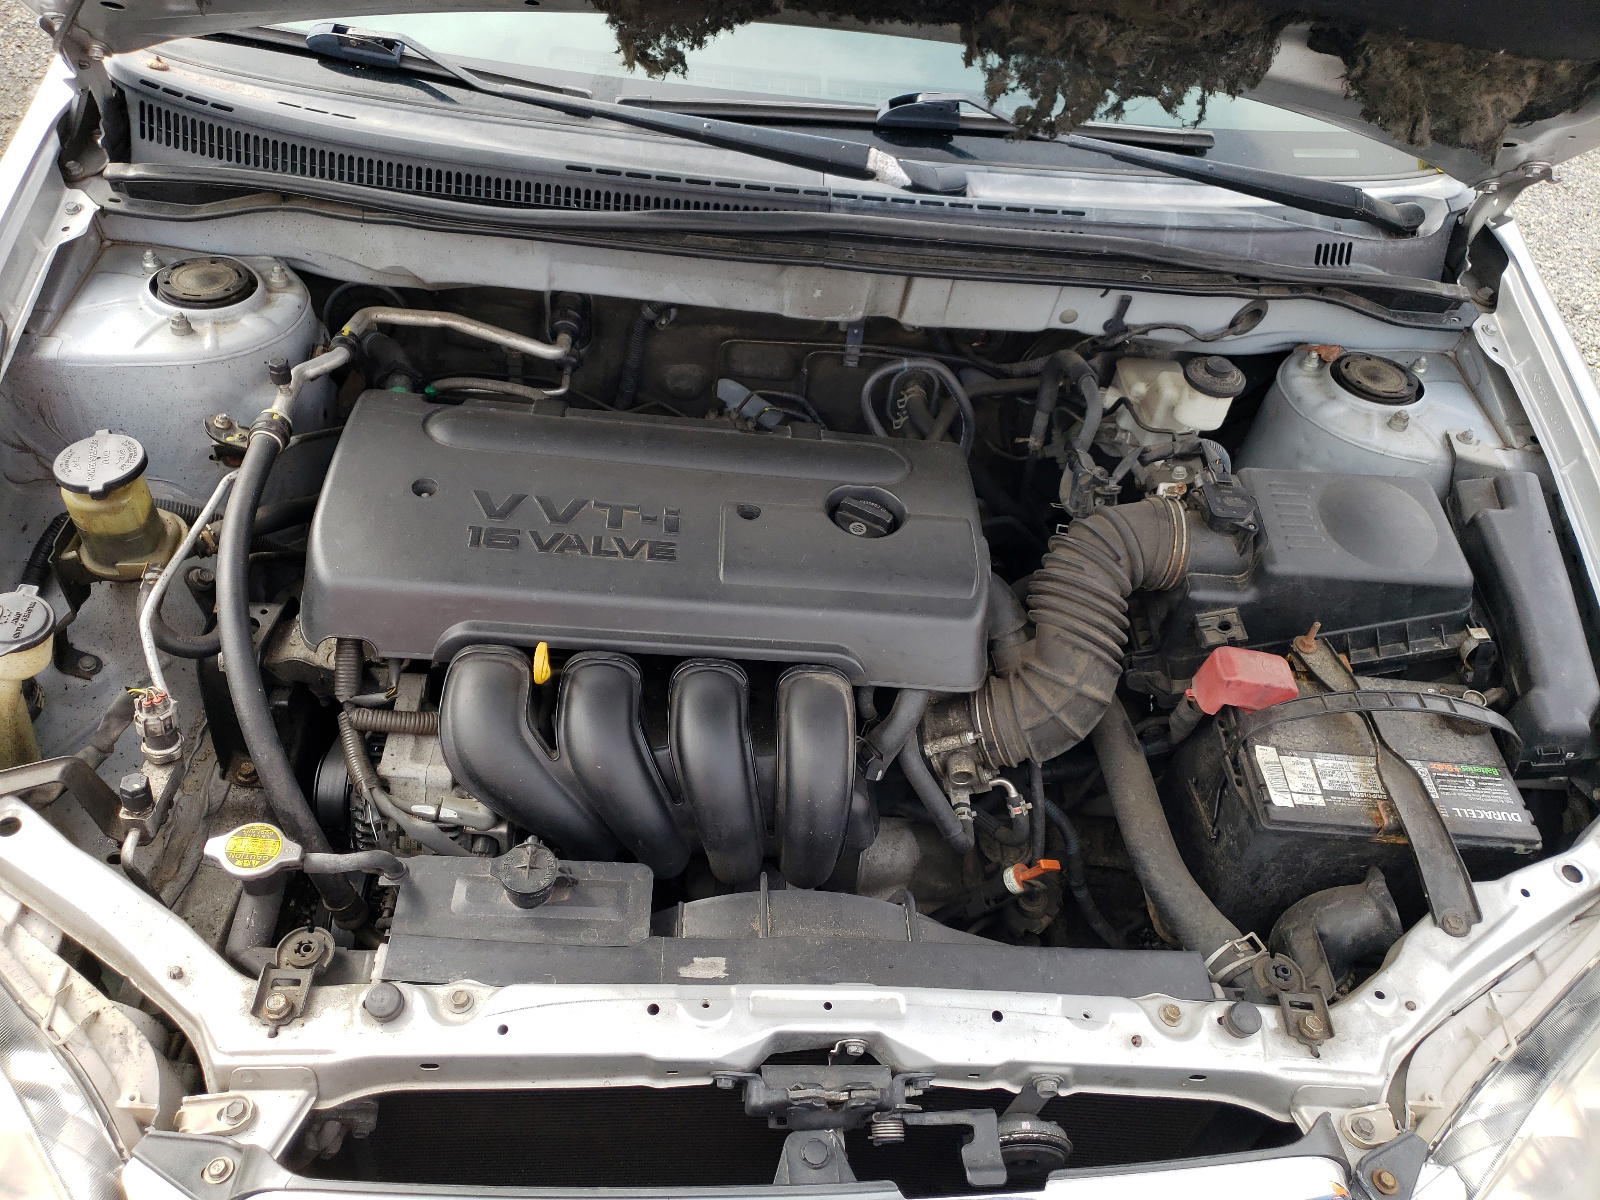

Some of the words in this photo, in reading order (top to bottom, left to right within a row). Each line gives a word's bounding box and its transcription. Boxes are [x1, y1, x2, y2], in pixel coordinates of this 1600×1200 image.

[467, 525, 521, 550] 16
[529, 530, 677, 562] VALVE
[1452, 807, 1523, 823] DURACELL
[229, 853, 269, 861] CAUTION
